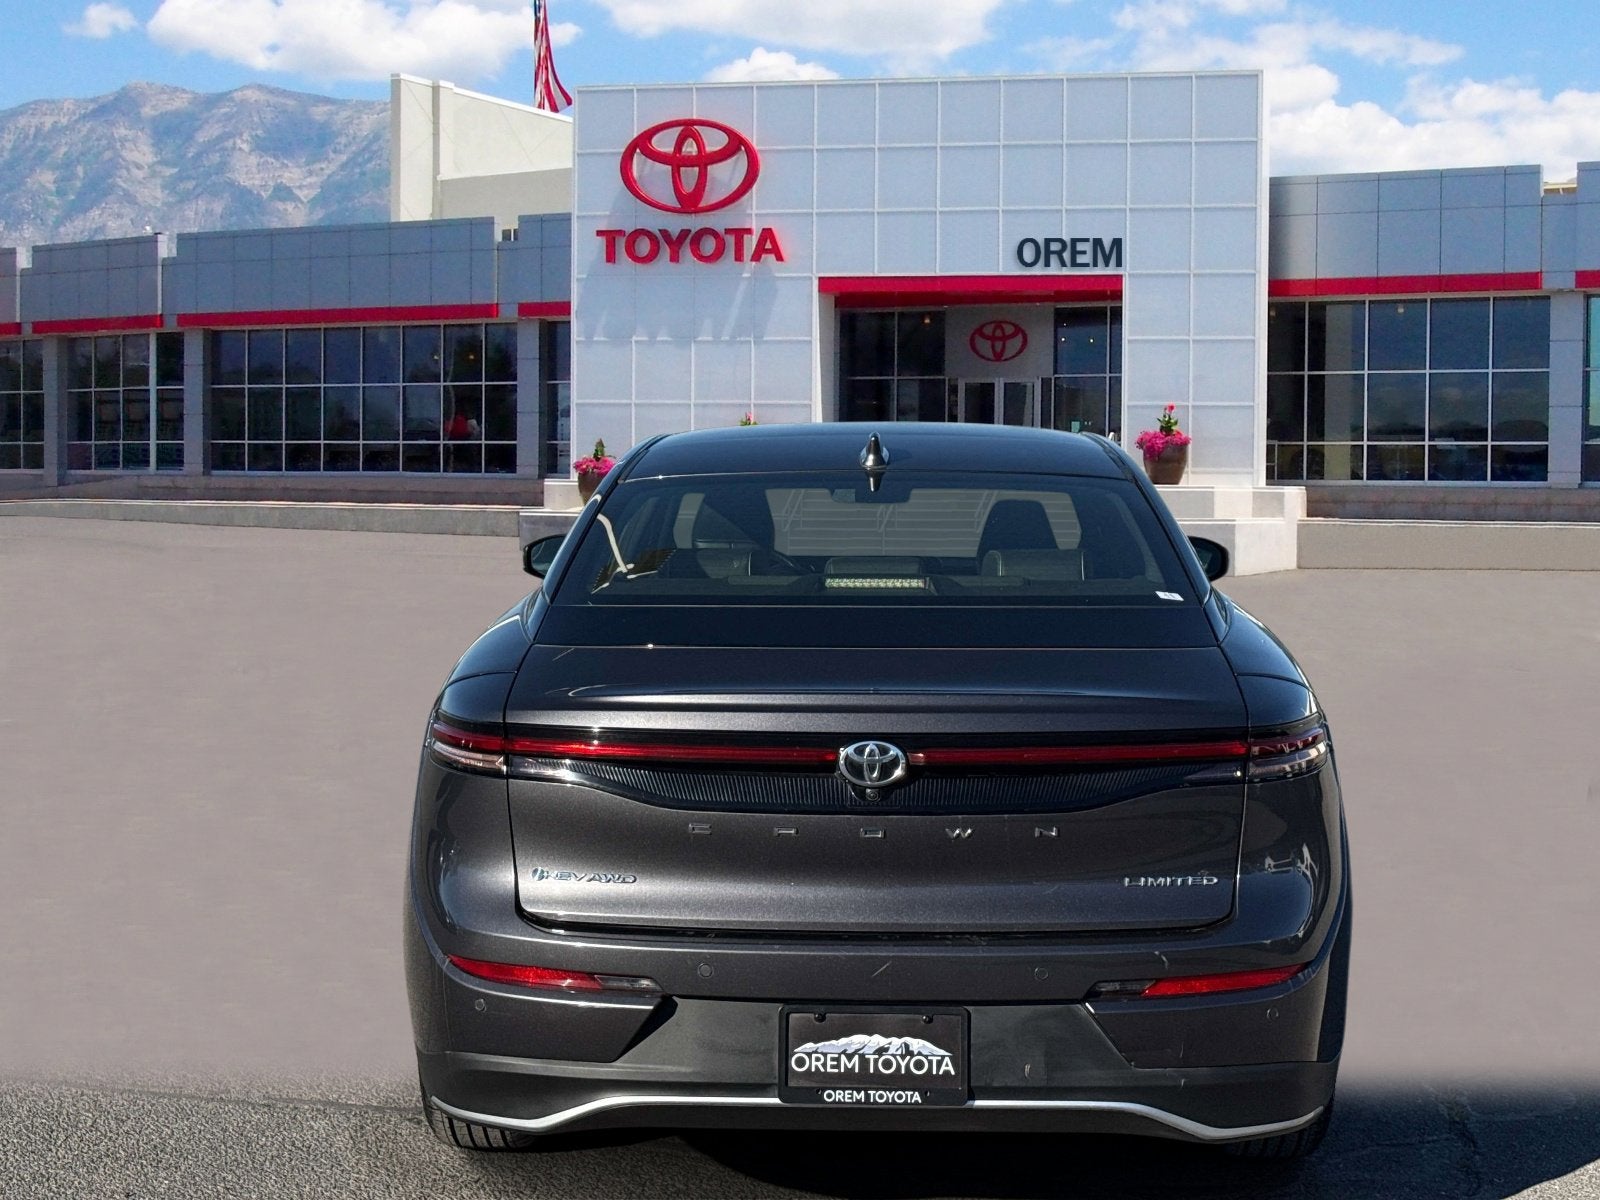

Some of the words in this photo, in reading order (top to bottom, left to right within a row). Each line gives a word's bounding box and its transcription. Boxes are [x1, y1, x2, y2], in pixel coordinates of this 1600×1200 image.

[596, 227, 784, 264] TOYOTA
[1017, 238, 1123, 268] OREM
[1124, 876, 1219, 888] LIMITED
[791, 1053, 859, 1073] OREM
[865, 1054, 956, 1076] TOYOTA
[823, 1089, 865, 1104] OREM
[867, 1090, 922, 1105] TOYOTA
